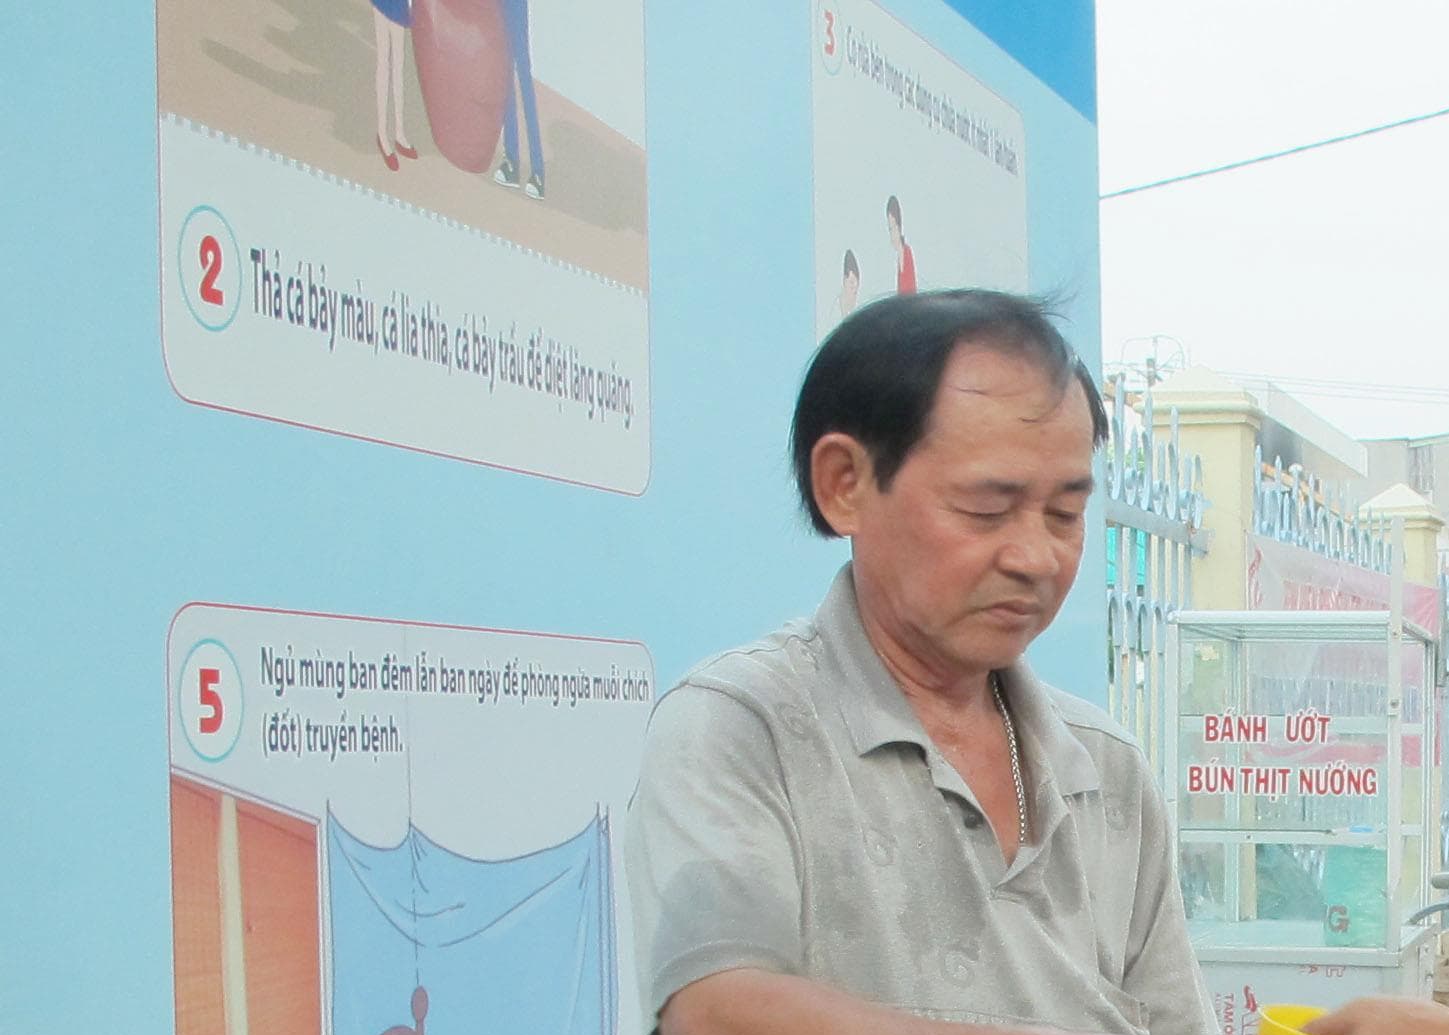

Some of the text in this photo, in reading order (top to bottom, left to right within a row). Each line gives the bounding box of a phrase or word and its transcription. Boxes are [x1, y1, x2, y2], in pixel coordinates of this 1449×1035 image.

[824, 9, 834, 56] 3
[199, 235, 223, 305] 2
[250, 248, 283, 320] Thả
[286, 261, 304, 325] cá
[308, 263, 337, 353] bảy
[341, 279, 379, 355] màu,
[382, 290, 398, 351] cá
[401, 292, 418, 357] lia
[422, 300, 452, 375] thia,
[455, 313, 469, 370] cá
[472, 313, 495, 394] bảy
[199, 668, 223, 733] 5
[261, 644, 296, 697] Ngủ
[299, 649, 345, 699] mùng
[349, 651, 377, 690] ban
[381, 653, 413, 691] đêm
[415, 651, 438, 693] lẫn
[440, 657, 466, 695] ban
[469, 660, 500, 704] ngày
[521, 662, 560, 707] phòng
[562, 667, 591, 707] ngừa
[593, 664, 622, 701] muỗi
[263, 707, 302, 758] (đốt)
[361, 714, 403, 763] bệnh.
[1204, 706, 1331, 743] BÁNH ƯỚT
[1188, 757, 1377, 803] BÚN THỊT NƯỚNG
